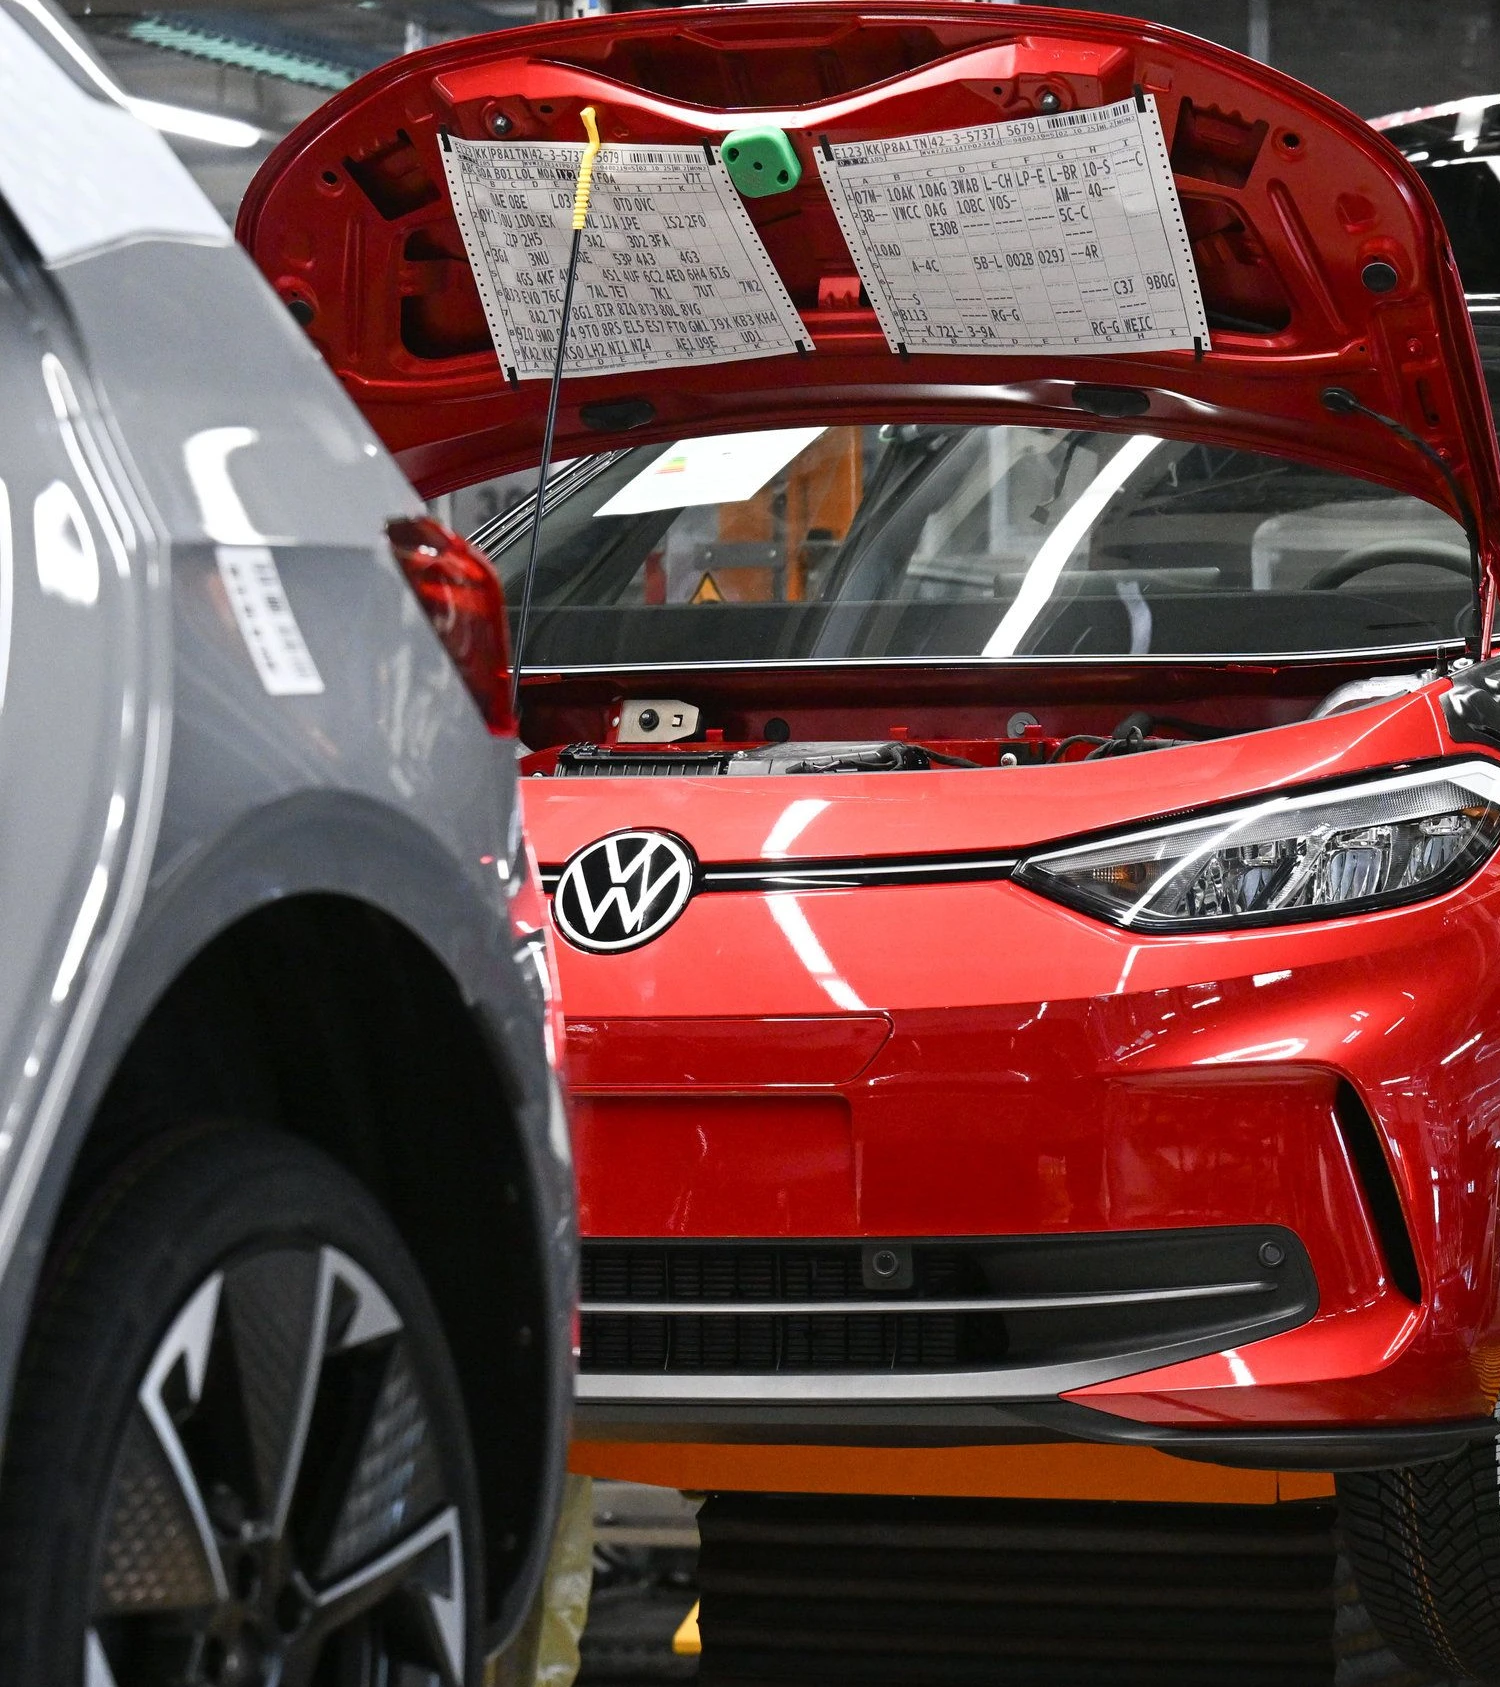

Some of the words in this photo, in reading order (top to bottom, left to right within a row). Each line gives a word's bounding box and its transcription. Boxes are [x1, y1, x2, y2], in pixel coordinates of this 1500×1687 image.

[834, 146, 862, 159] E123
[866, 144, 881, 156] KK
[931, 128, 994, 149] 42-3-5737
[1006, 122, 1035, 137] 5679
[475, 148, 488, 159] KK
[490, 148, 529, 160] P8A1TN
[596, 151, 619, 163] 5679
[983, 173, 1013, 191] L-CH
[1015, 168, 1045, 186] LP-E
[1048, 164, 1078, 182] L-BR
[892, 205, 921, 221] VWCC
[535, 214, 556, 228] 1EX
[620, 216, 641, 230] 1PE
[663, 215, 685, 229] 1S2
[520, 232, 543, 248] 2H5
[584, 234, 605, 248] 3A2
[649, 234, 671, 247] 3FA
[529, 251, 550, 267] 3NU
[636, 253, 656, 266] 4A3
[679, 251, 700, 264] 4G3
[912, 259, 940, 273] A-4C
[536, 270, 556, 285] 4KF
[642, 270, 665, 283] 6C2
[688, 268, 708, 281] 6H4
[587, 284, 608, 298] 7AL
[608, 285, 629, 298] 7E7
[650, 287, 672, 300] 7K1
[693, 284, 715, 298] 7UT
[1113, 278, 1134, 295] C3J
[549, 308, 564, 323] 7Y
[572, 305, 593, 320] 8G1
[638, 302, 659, 316] 8T3
[680, 302, 702, 316] 8VG
[990, 309, 1020, 322] RG-G
[601, 323, 623, 337] 8RS
[623, 320, 645, 334] EL5
[645, 319, 665, 333] ES7
[732, 314, 755, 328] KB3
[755, 311, 778, 325] KH4
[1091, 320, 1120, 336] RG-G
[1123, 316, 1153, 334] WEIC
[585, 343, 607, 358] LH2
[630, 338, 651, 352] NZ4
[695, 336, 718, 349] U9E
[563, 835, 685, 942] VW
